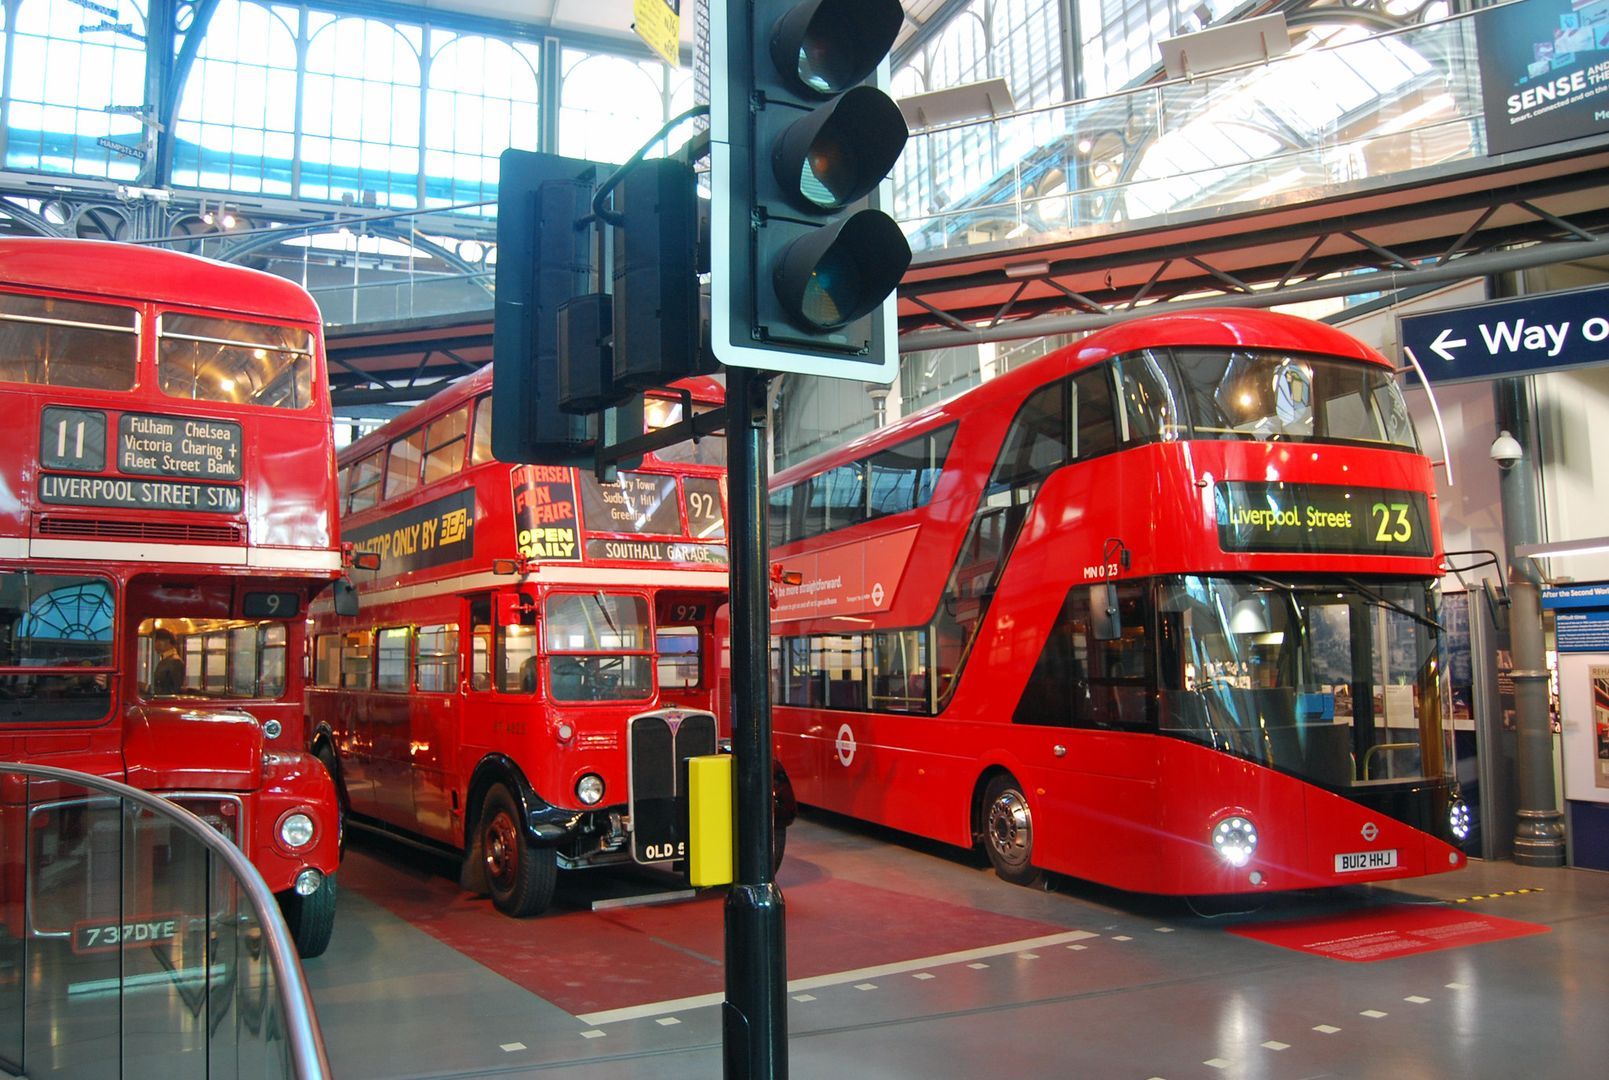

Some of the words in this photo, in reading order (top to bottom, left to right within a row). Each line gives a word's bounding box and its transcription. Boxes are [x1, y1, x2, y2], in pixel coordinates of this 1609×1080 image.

[1588, 70, 1609, 85] THE
[1507, 70, 1586, 114] SENSE
[1533, 98, 1570, 117] connected
[1570, 92, 1585, 103] and
[1585, 89, 1595, 98] on
[100, 139, 144, 159] HAMPSTEAD
[1478, 318, 1570, 357] Way
[57, 419, 85, 459] 11
[131, 417, 174, 436] Fulham
[185, 422, 231, 441] Chelsea
[125, 434, 172, 453] Victoria
[182, 440, 223, 460] Charing
[124, 452, 156, 470] Fleet
[162, 454, 201, 473] Street
[207, 458, 236, 475] Bank
[512, 465, 571, 490] BATTERSEA
[635, 478, 656, 491] Town
[43, 477, 136, 502] LIVERPOOL
[142, 482, 200, 505] STREET
[207, 486, 237, 507] STN
[515, 485, 552, 515] FUN
[640, 494, 657, 506] Hill
[533, 501, 574, 528] FAIR
[689, 492, 716, 520] 92
[1230, 504, 1302, 531] Liverpool
[1306, 504, 1352, 529] Street
[1372, 502, 1413, 543] 23
[392, 523, 420, 558] ONLY
[422, 518, 438, 550] BY
[518, 528, 574, 546] OPEN
[518, 542, 575, 558] DAILY
[606, 543, 662, 560] SOUTHALL
[666, 545, 710, 561] GARAGE
[1083, 566, 1098, 579] MN
[267, 593, 280, 612] 9
[1542, 591, 1558, 599] After
[1559, 590, 1570, 598] the
[1571, 588, 1593, 597] Second
[676, 605, 696, 621] 92
[646, 843, 673, 859] OLD
[1342, 854, 1367, 870] BU12
[1369, 852, 1391, 867] HHJ
[86, 920, 176, 947] 737DYE
